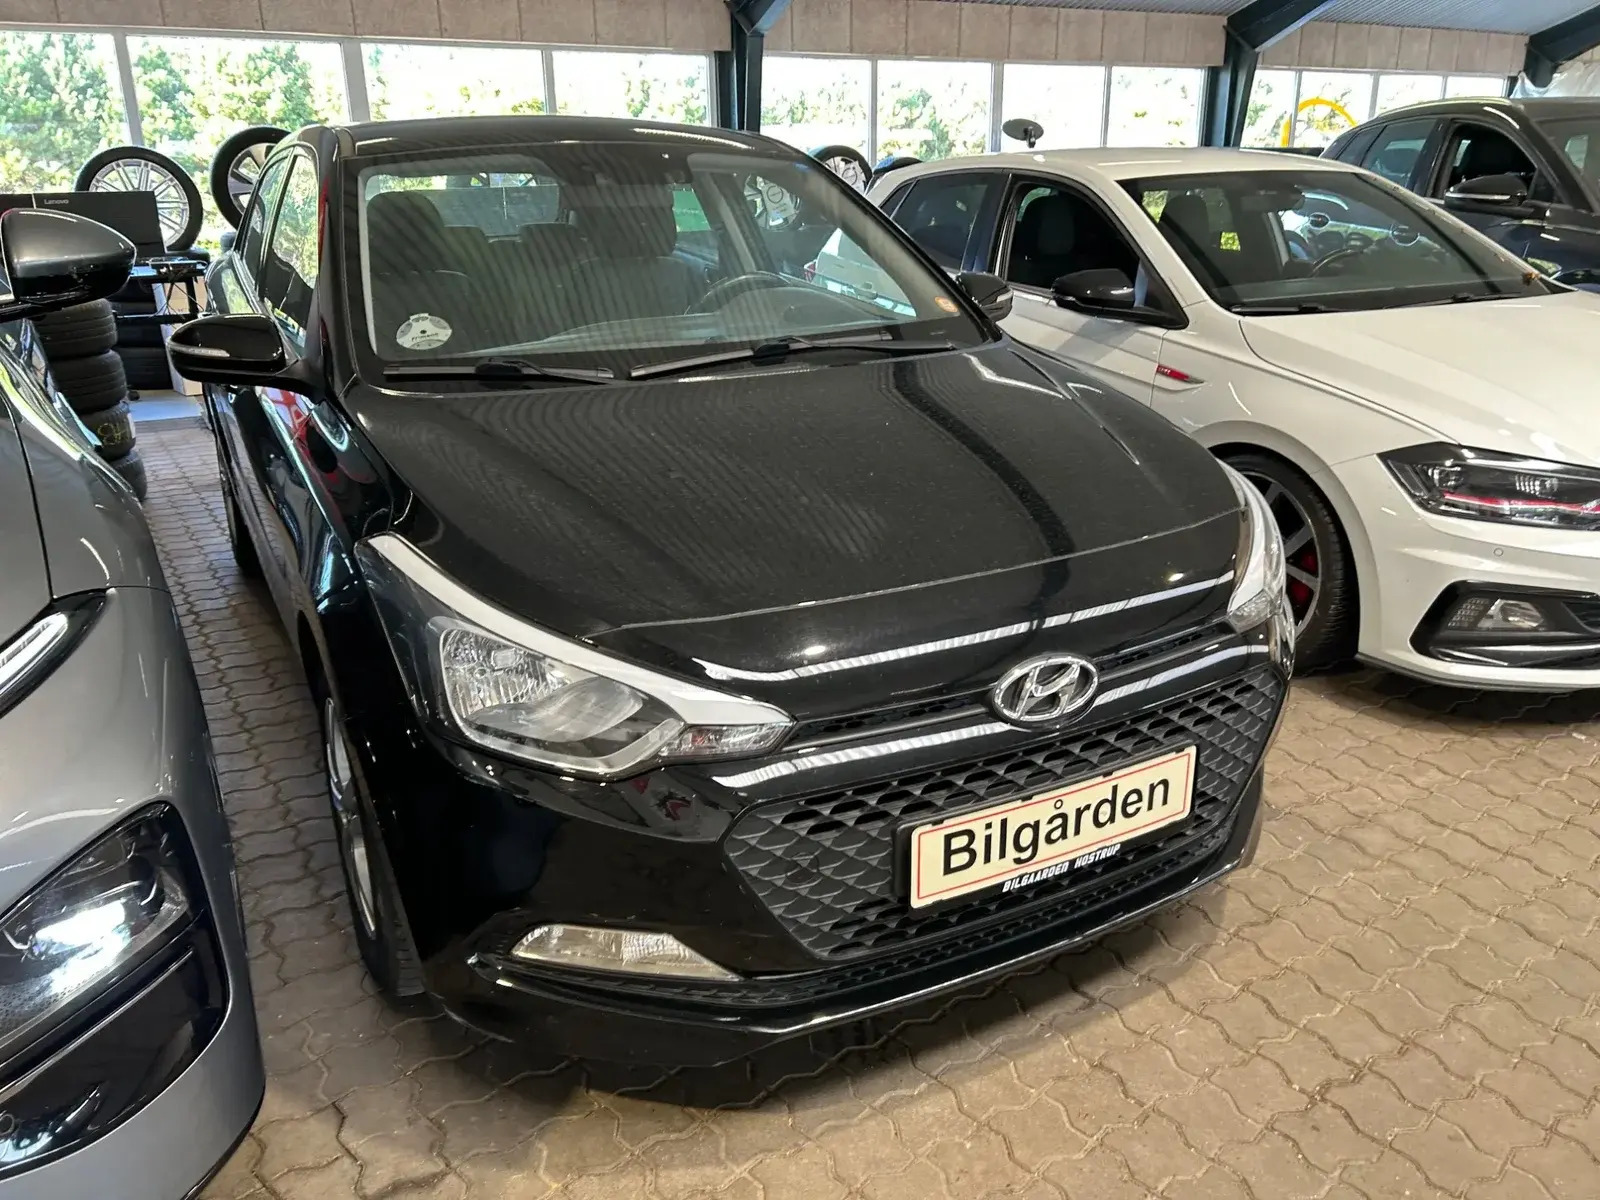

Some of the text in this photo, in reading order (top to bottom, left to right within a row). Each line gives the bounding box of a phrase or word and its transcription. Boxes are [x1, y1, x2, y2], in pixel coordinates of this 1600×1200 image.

[943, 778, 1170, 876] Bilgården
[1002, 843, 1121, 892] BILGAARDEN HOSTRUP
